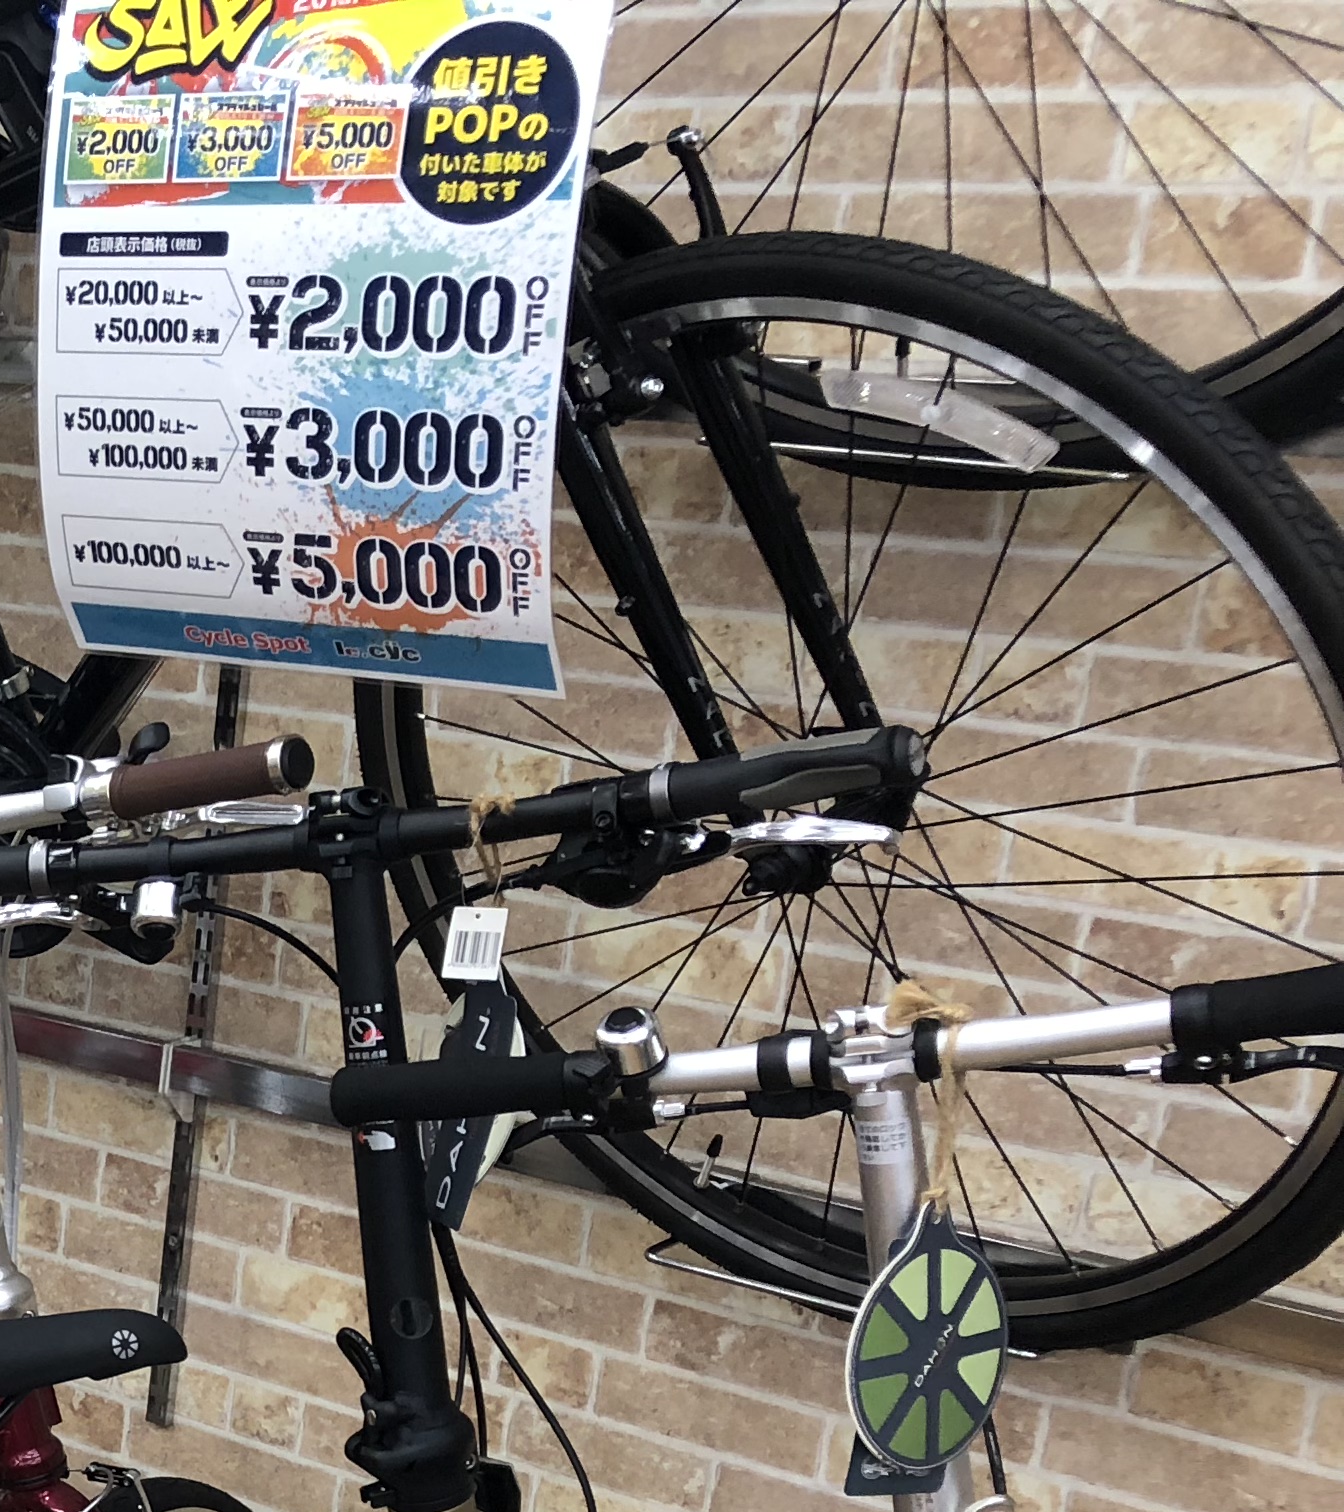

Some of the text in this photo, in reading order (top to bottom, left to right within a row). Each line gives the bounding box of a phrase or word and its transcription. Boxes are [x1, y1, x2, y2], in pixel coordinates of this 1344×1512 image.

[432, 54, 548, 99] 値引き
[187, 124, 273, 152] ¥3,000
[302, 121, 393, 150] ¥5,000
[424, 104, 548, 145] POPの
[77, 129, 159, 155] ¥2,000
[103, 159, 135, 174] OFF
[214, 156, 248, 171] OFF
[330, 153, 366, 170] OFF
[419, 150, 548, 177] 付いた車体が
[437, 180, 520, 203] 対象です
[64, 280, 159, 306] ¥20,000
[248, 274, 518, 354] ¥2,000
[95, 318, 188, 344] ¥50,000
[63, 408, 154, 435] ¥50,000
[89, 445, 187, 471] ¥100,000
[245, 407, 504, 489] ¥3,000
[74, 541, 181, 569] ¥100,000
[251, 534, 502, 613] ¥5,000
[185, 625, 247, 647] Cycle
[253, 632, 310, 654] Spot
[436, 1014, 492, 1210] DAHN
[914, 1323, 954, 1389] DAHON
